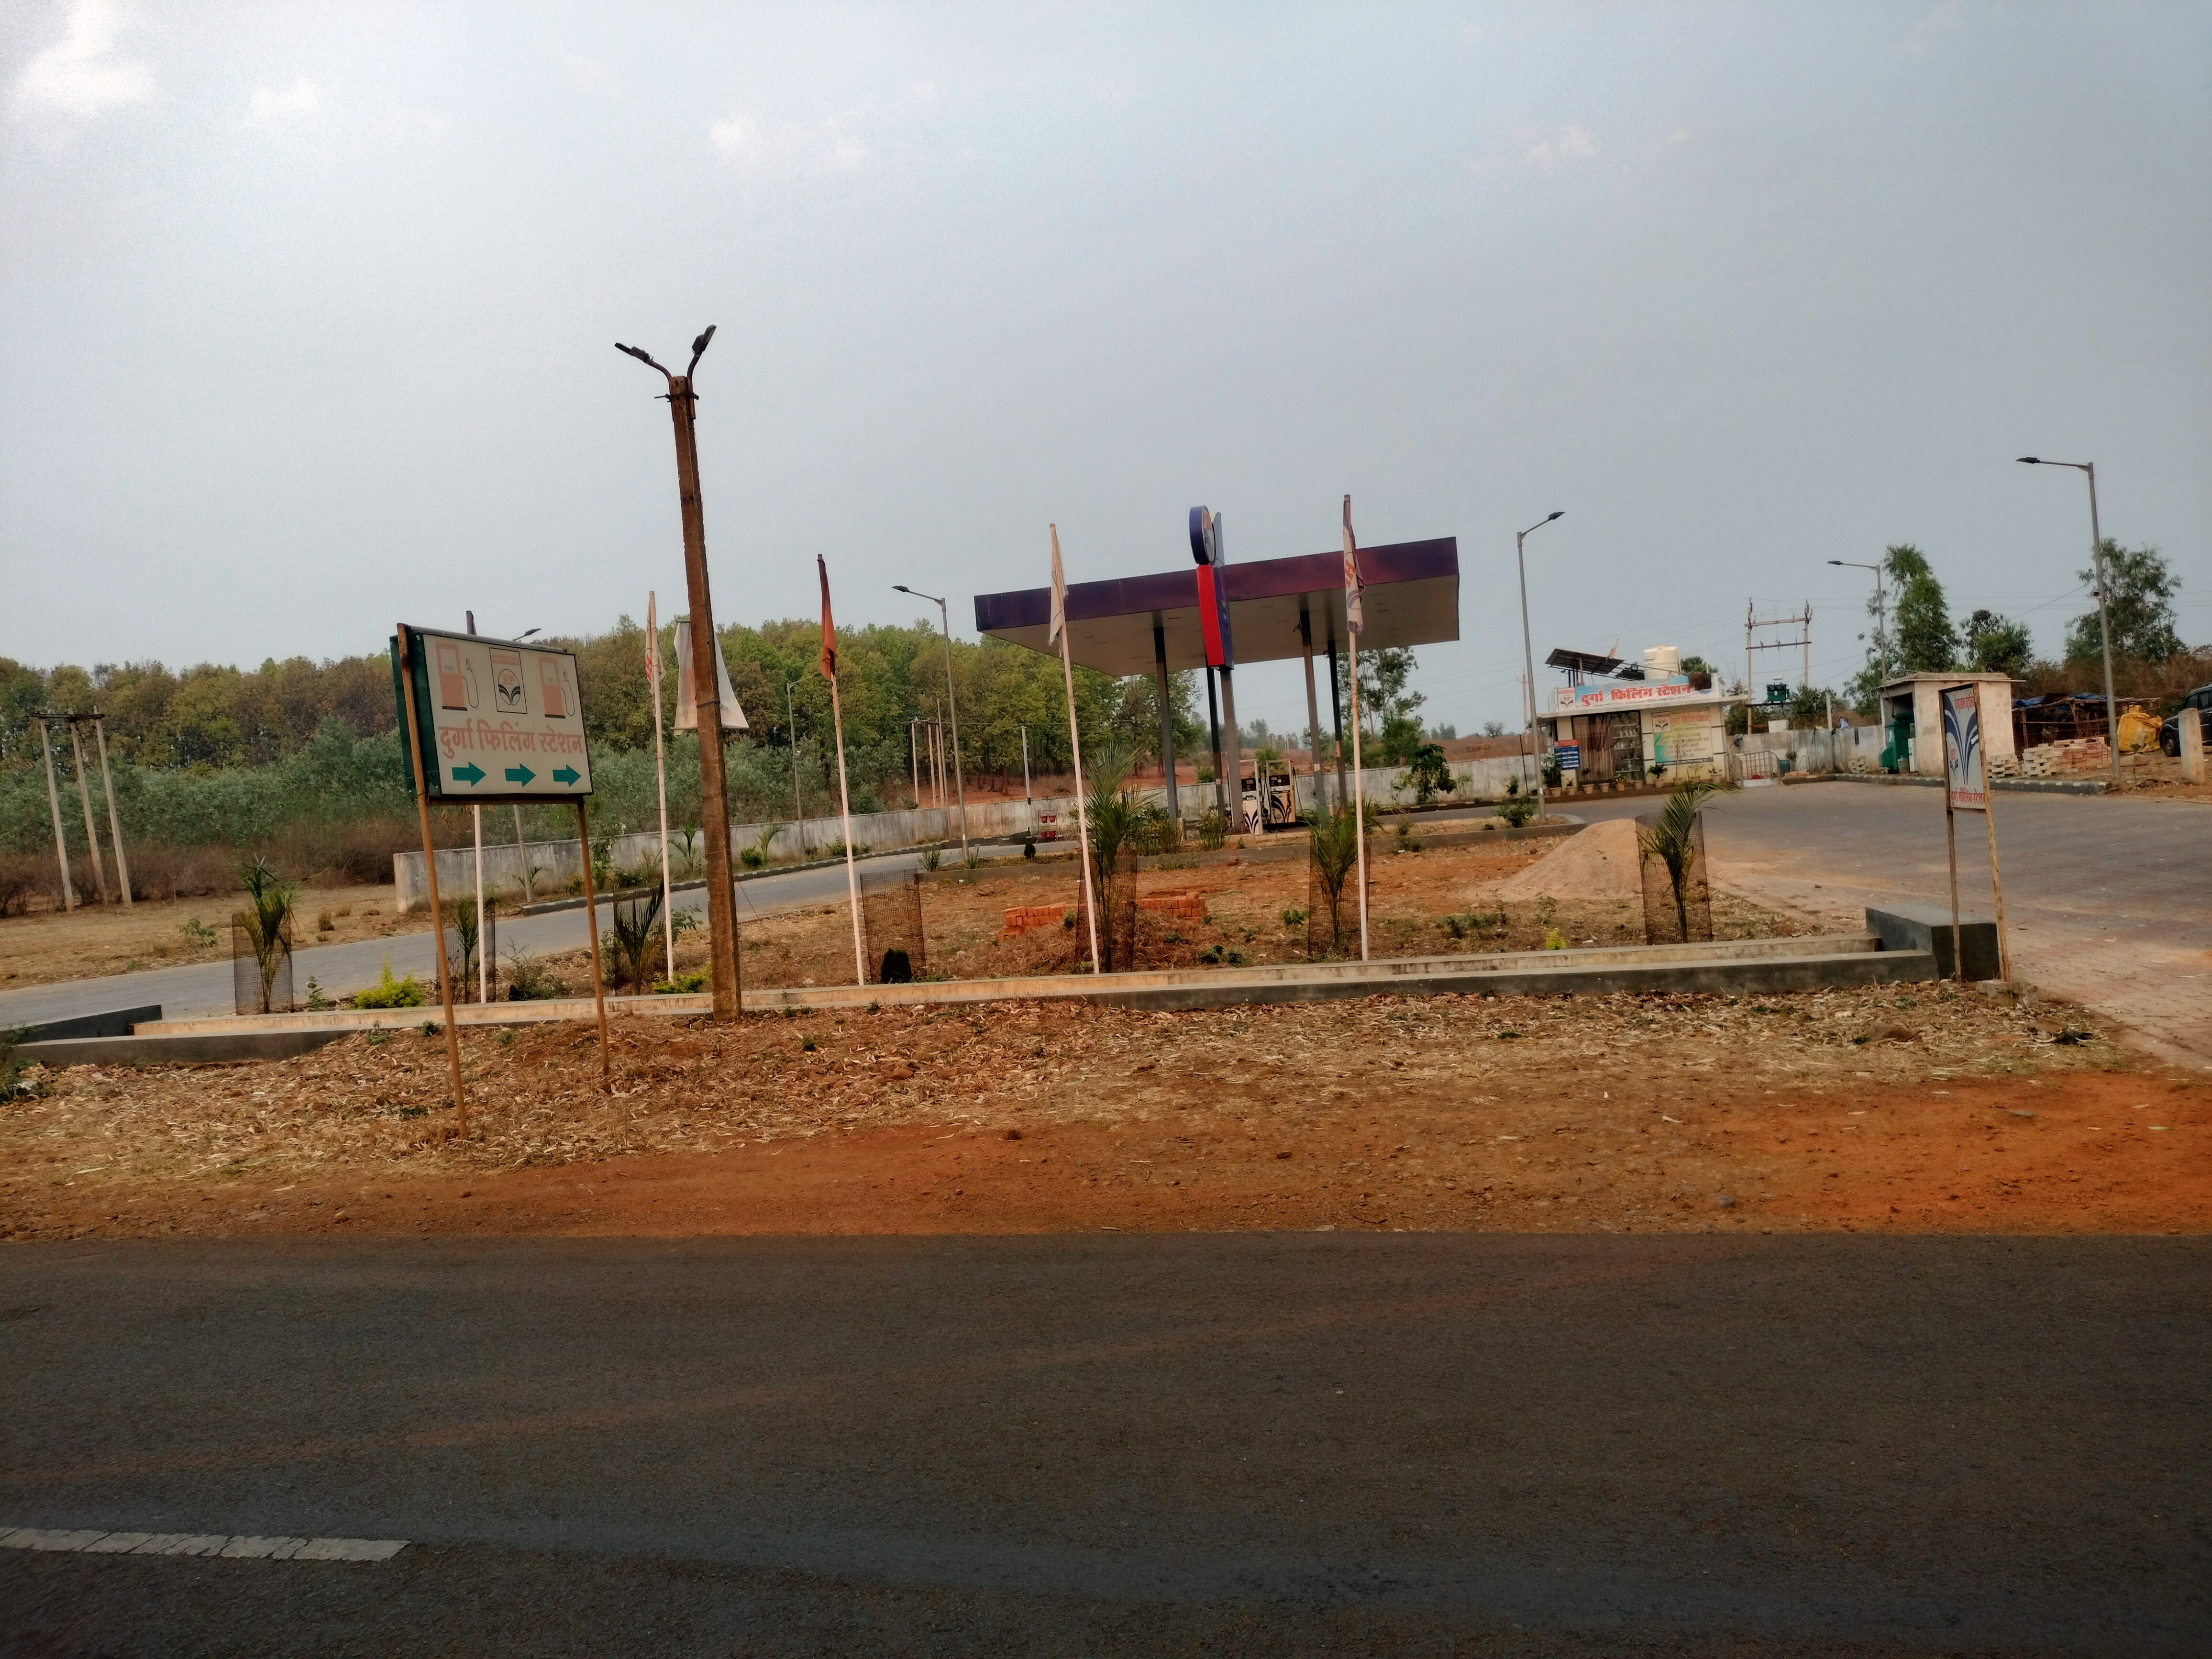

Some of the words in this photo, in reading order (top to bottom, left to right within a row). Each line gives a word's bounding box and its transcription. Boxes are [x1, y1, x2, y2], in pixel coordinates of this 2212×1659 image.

[503, 674, 515, 686] HP
[1581, 690, 1604, 707] दुर्गा
[1610, 686, 1652, 701] फिलिंग
[1656, 684, 1691, 697] स्टेशन
[438, 718, 473, 760] दुर्गा
[476, 719, 536, 752] फिलिंग
[537, 724, 583, 754] स्टेशन
